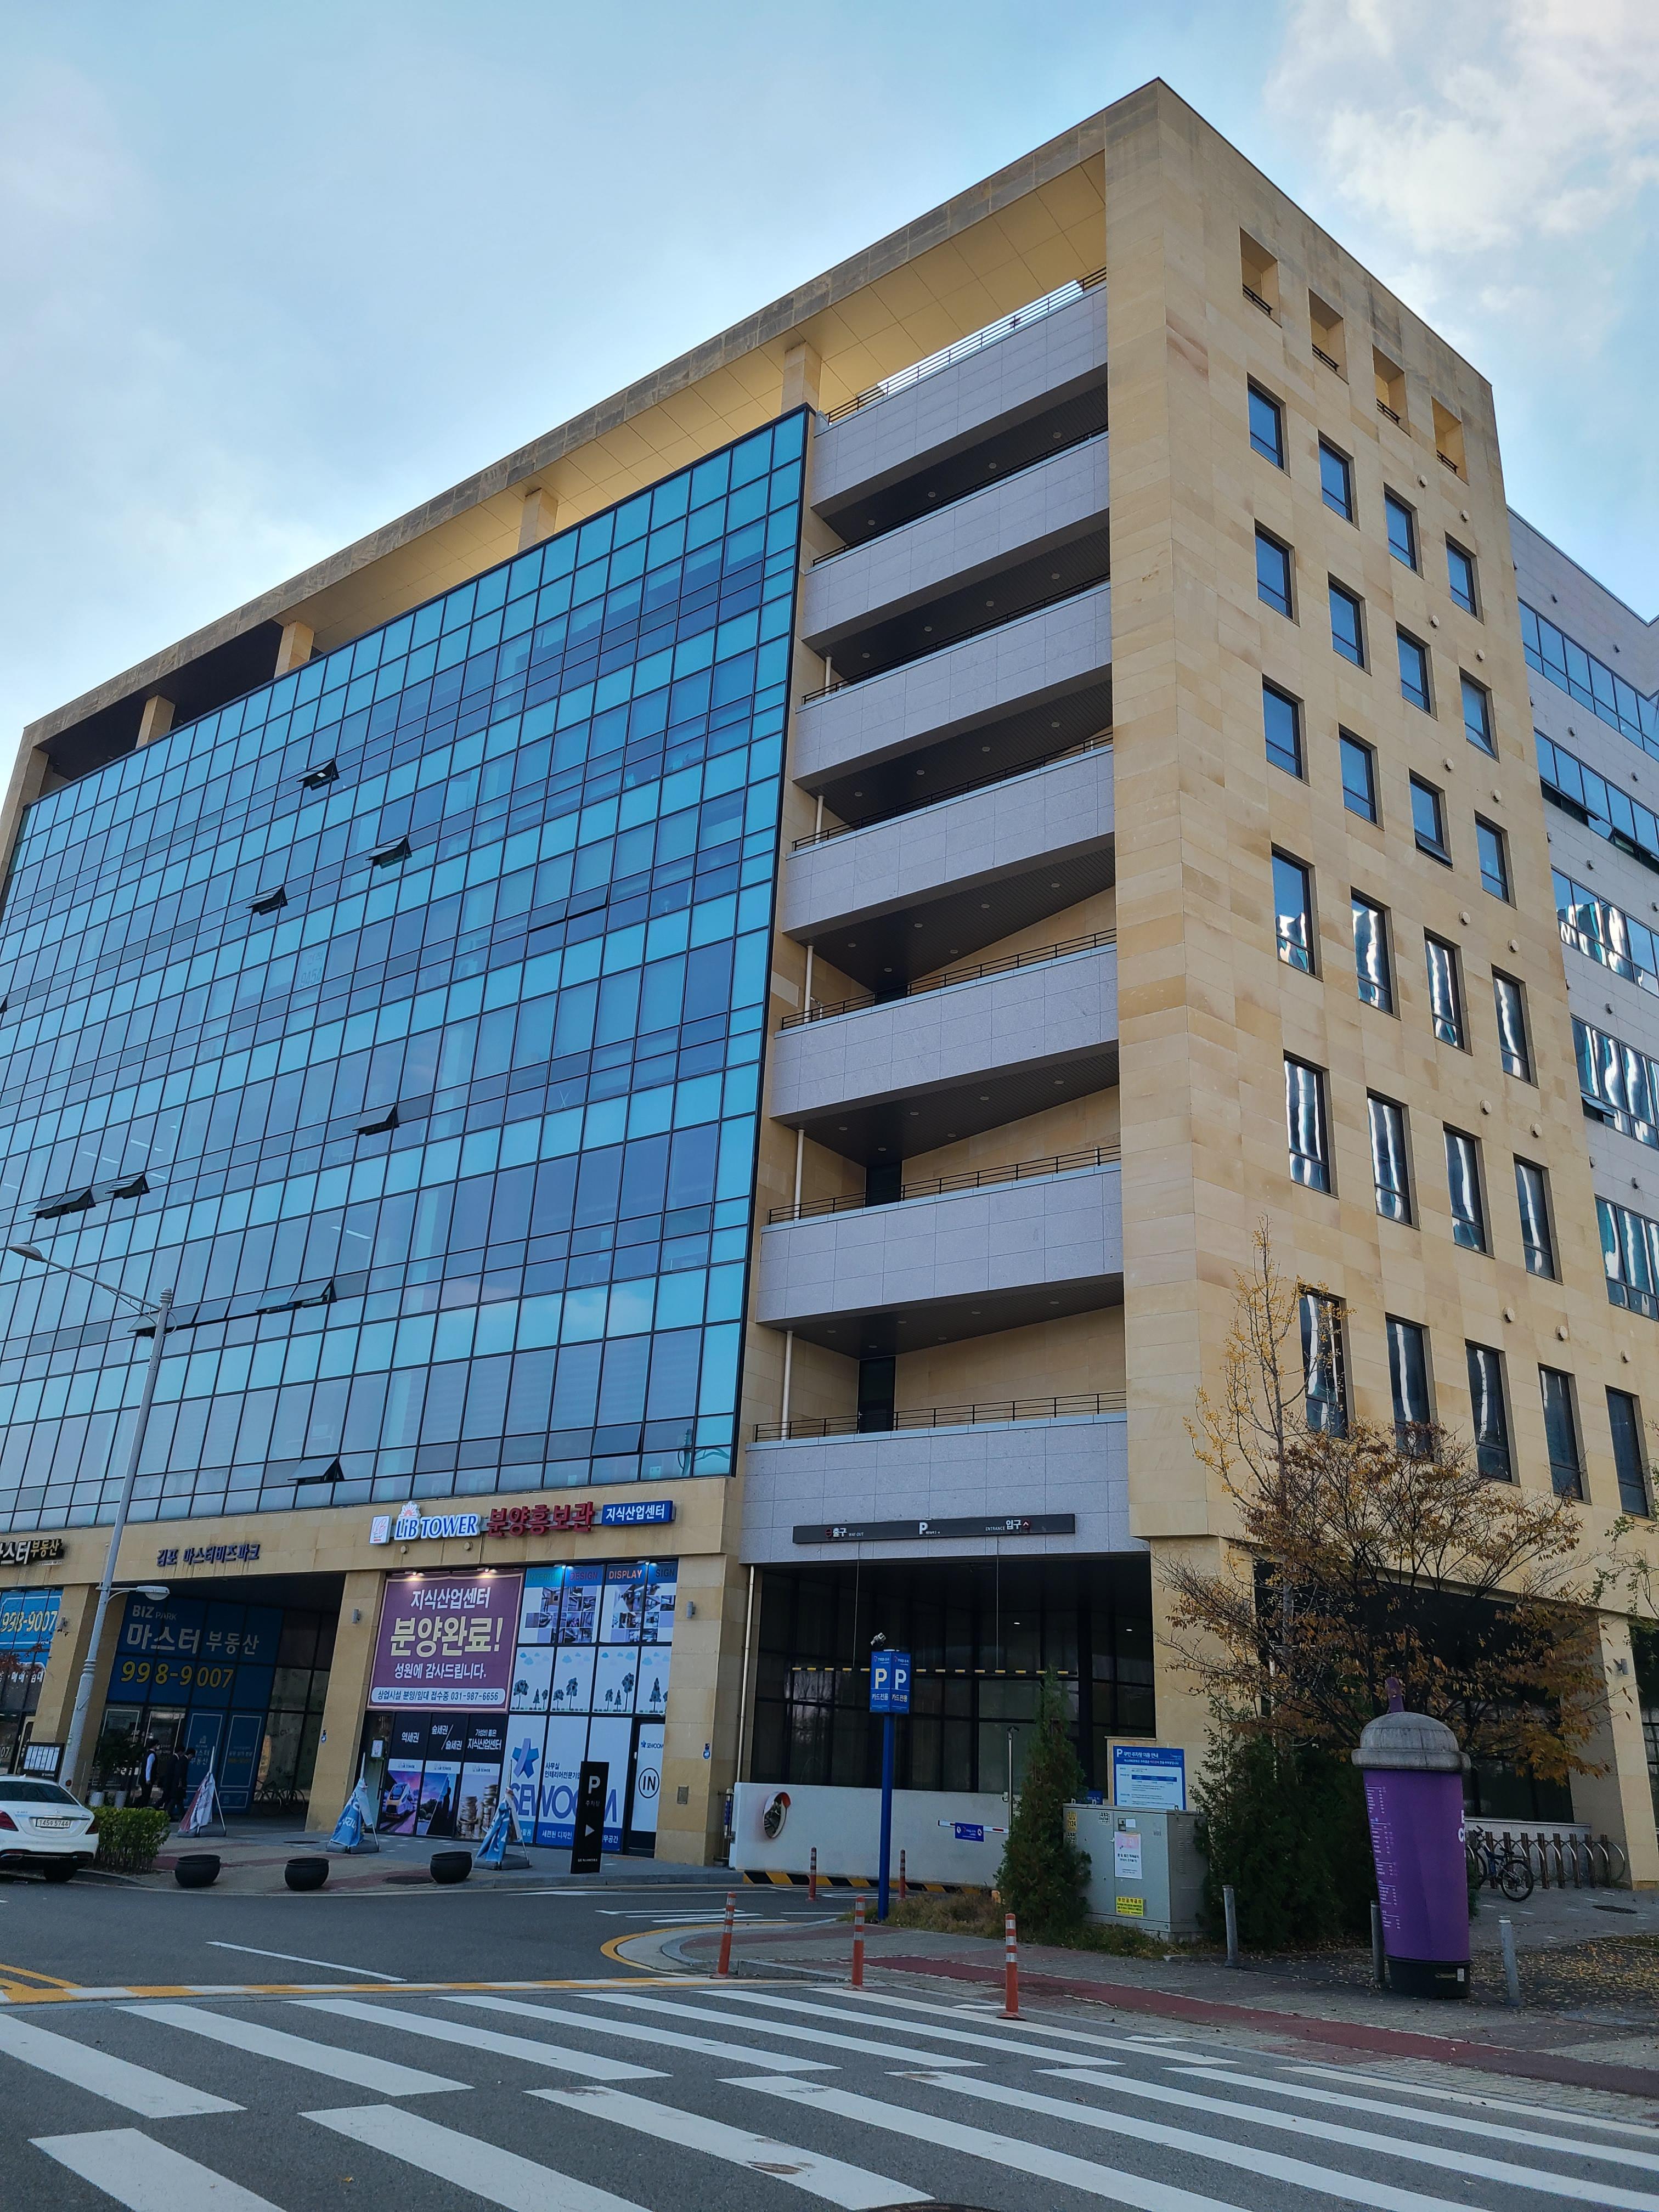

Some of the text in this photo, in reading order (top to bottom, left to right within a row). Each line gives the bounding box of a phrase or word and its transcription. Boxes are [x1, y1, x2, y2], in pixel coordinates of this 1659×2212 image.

[487, 1502, 595, 1536] 분양홍보관
[606, 1504, 665, 1522] 지식산업센터
[421, 1516, 477, 1536] TOWER
[919, 1522, 928, 1534] P
[1006, 1520, 1022, 1530] 입구
[832, 1527, 848, 1537] 출구
[0, 1539, 60, 1565] 스터 부동산
[157, 1544, 261, 1567] 김포 마스터비즈파크
[570, 1571, 597, 1580] DESIGN
[609, 1570, 642, 1579] DISPLAY
[656, 1568, 675, 1577] SIGN
[411, 1587, 490, 1610] 지식산업센터
[132, 1605, 177, 1621] BIZ PARK
[127, 1623, 259, 1655] 마스터 부동산
[390, 1616, 503, 1657] 분양완료!
[121, 1661, 234, 1688] 998-9007
[394, 1663, 487, 1679] 성원에 감사드립니다.
[875, 1668, 887, 1689] P
[895, 1669, 907, 1690] P
[377, 1690, 499, 1701] 상업시설 분양/임대 접수중 031-987-6656
[891, 1694, 908, 1702] 카드전용
[431, 1725, 448, 1735] 숲세권
[475, 1729, 488, 1737] 가성비
[402, 1732, 420, 1743] 역세권
[445, 1740, 462, 1750] 슬세권
[467, 1738, 502, 1750] 지식산업센터
[1116, 1748, 1123, 1757] P
[545, 1762, 560, 1770] 사무실
[588, 1776, 601, 1794] P
[643, 1776, 656, 1791] IN
[557, 1831, 572, 1839] 디자인
